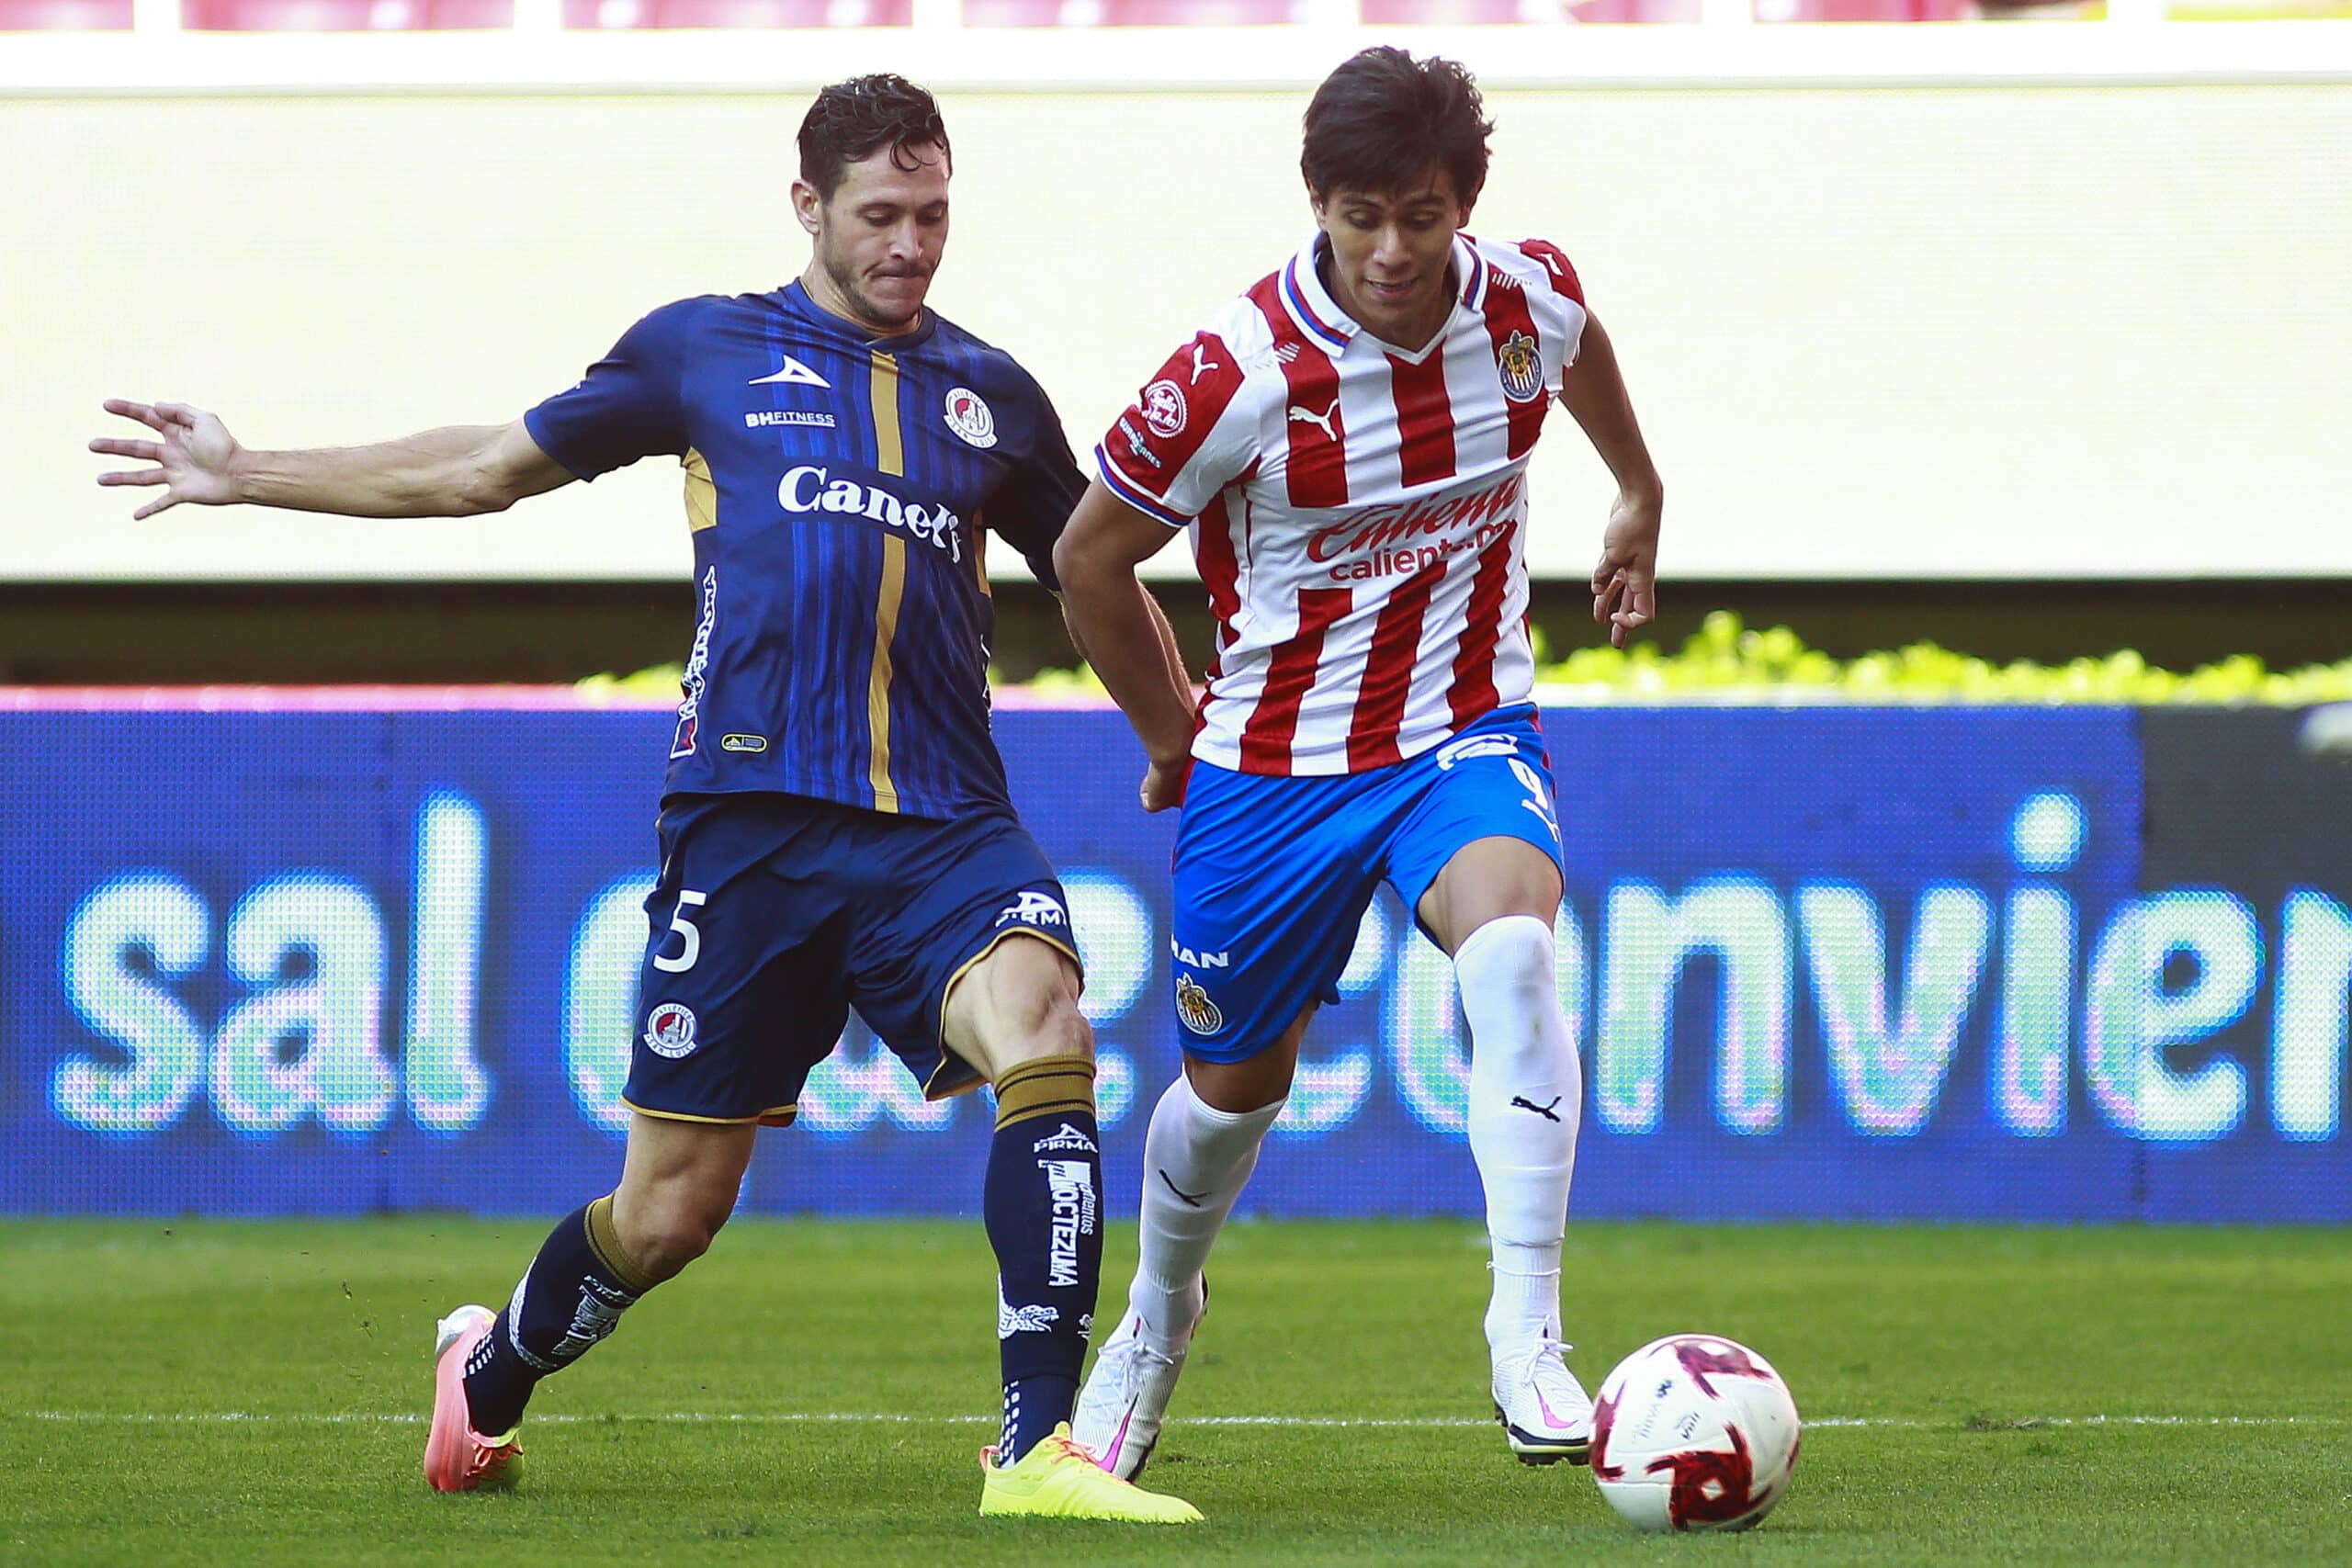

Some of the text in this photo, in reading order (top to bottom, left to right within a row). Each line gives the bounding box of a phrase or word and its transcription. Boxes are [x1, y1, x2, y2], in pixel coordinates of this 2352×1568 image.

[1508, 757, 1549, 811] 9
[51, 788, 494, 1137] sal
[653, 889, 707, 973] 5
[1034, 1139, 1099, 1154] PIRMA
